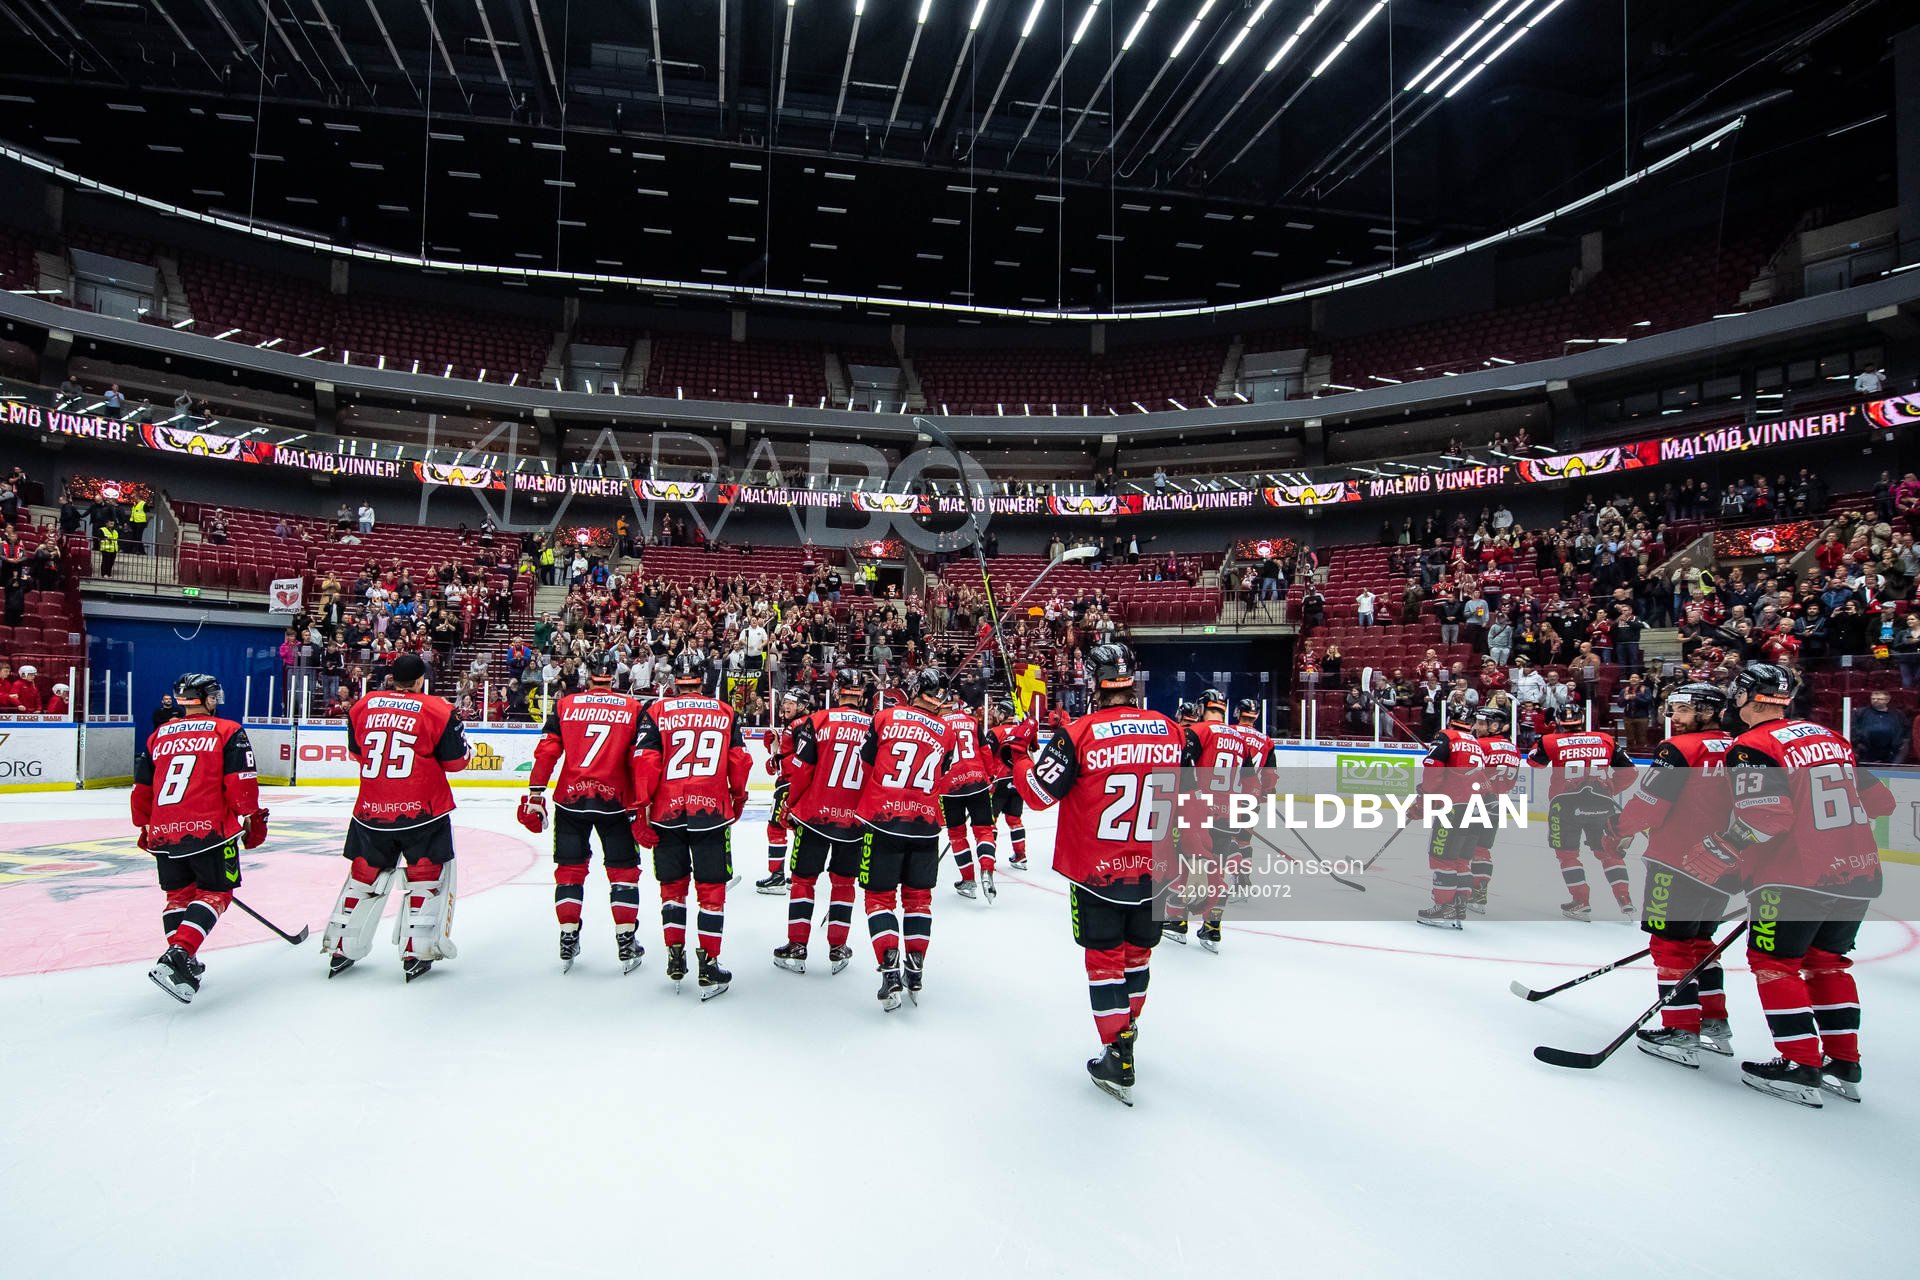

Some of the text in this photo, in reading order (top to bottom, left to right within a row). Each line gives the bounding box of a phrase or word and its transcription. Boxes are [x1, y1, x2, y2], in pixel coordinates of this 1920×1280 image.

[47, 411, 128, 442] VINNER!
[1660, 411, 1846, 461] MALMÖ VINNER!
[274, 446, 400, 478] MALMÖ VINNER!
[418, 414, 992, 553] KLARABO
[515, 474, 624, 496] MALMÖ VINNER!
[1370, 465, 1505, 497] MALMÖ VINNER!
[740, 488, 841, 507] MALMÖ VINNER!
[988, 497, 1039, 513] VINNER!
[1143, 491, 1252, 511] MALMÖ VINNER!
[377, 697, 421, 712] bravida
[585, 695, 626, 706] bravida
[676, 700, 719, 709] bravida
[365, 712, 417, 732] WERNER
[563, 708, 632, 724] LAURIDSEN
[658, 714, 729, 731] ENGSTRAND
[840, 713, 873, 724] bravid
[906, 711, 944, 736] bravida
[167, 721, 215, 735] bravida
[1111, 720, 1167, 736] bravida
[580, 723, 612, 768] 7
[881, 722, 945, 757] SÖDERBERG
[245, 750, 255, 768] 8
[361, 731, 418, 779] 35
[666, 730, 724, 781] 29
[1086, 744, 1183, 770] SCHEMITSCH
[1559, 747, 1607, 761] PERSSON
[828, 743, 864, 790] 10
[882, 741, 941, 794] 34
[1036, 756, 1066, 784] 26
[1342, 759, 1410, 779] RYDS
[157, 754, 197, 807] 8
[1736, 773, 1764, 796] 63
[371, 801, 422, 814] BJURFORS
[831, 807, 857, 819] BJUR
[893, 800, 936, 817] BJURFORS
[1097, 773, 1177, 842] 26
[161, 820, 212, 834] BJRFORS
[1552, 816, 1562, 848] akea
[1433, 822, 1449, 856] ake
[859, 832, 874, 885] akea
[1113, 855, 1168, 872] BJURFOR
[1646, 872, 1674, 930] akea
[1753, 889, 1782, 952] akea
[1574, 963, 1615, 984] CCM
